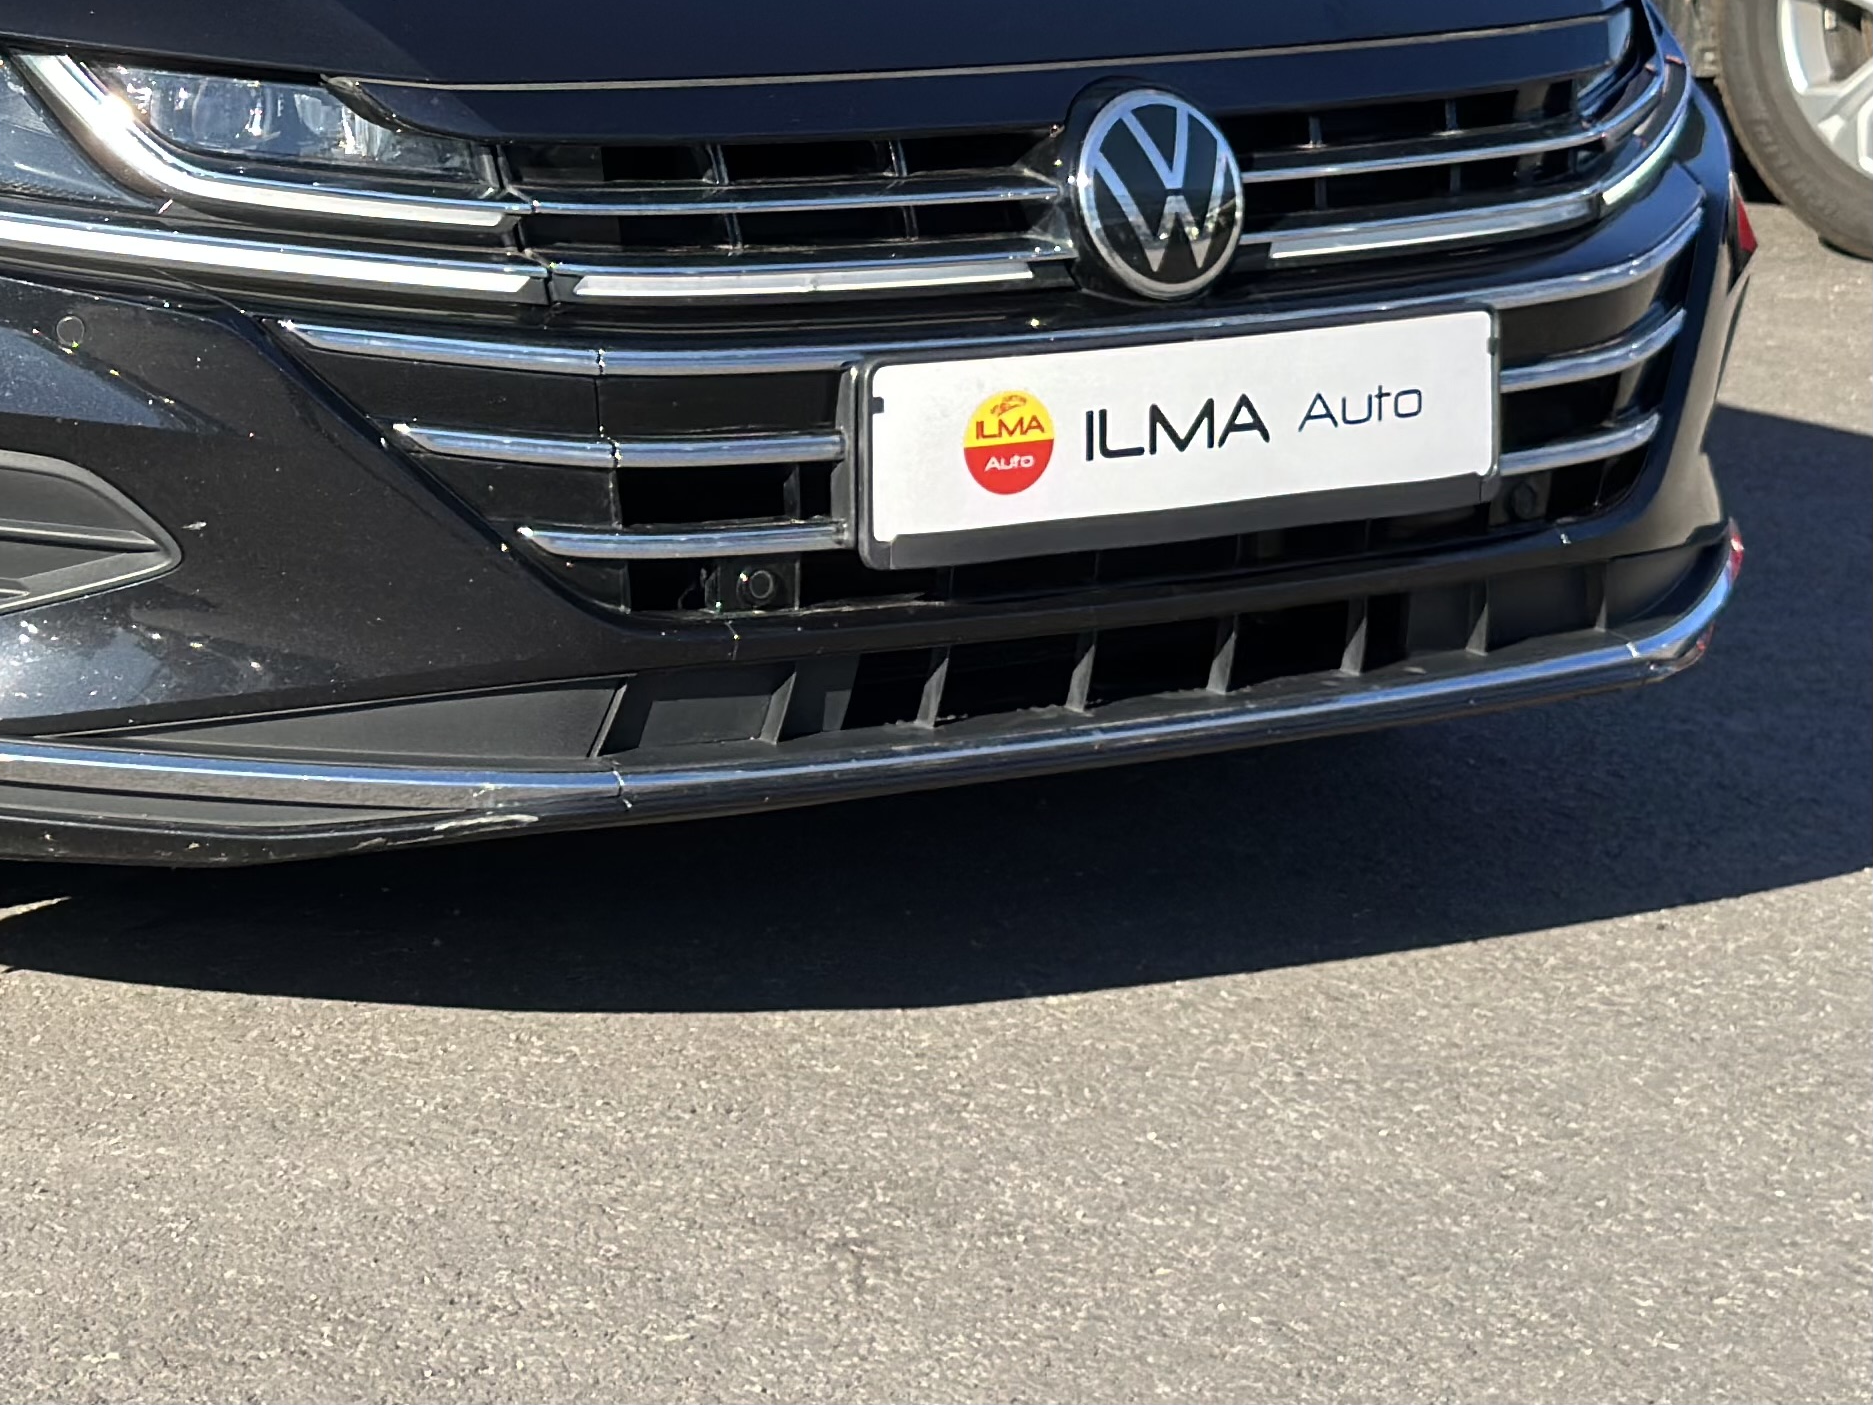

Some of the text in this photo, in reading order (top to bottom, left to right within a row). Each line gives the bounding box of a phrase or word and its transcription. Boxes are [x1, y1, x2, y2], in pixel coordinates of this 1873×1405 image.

[975, 414, 1045, 441] ILMA
[1085, 384, 1423, 462] ILMA Auto
[984, 454, 1035, 472] Auto
